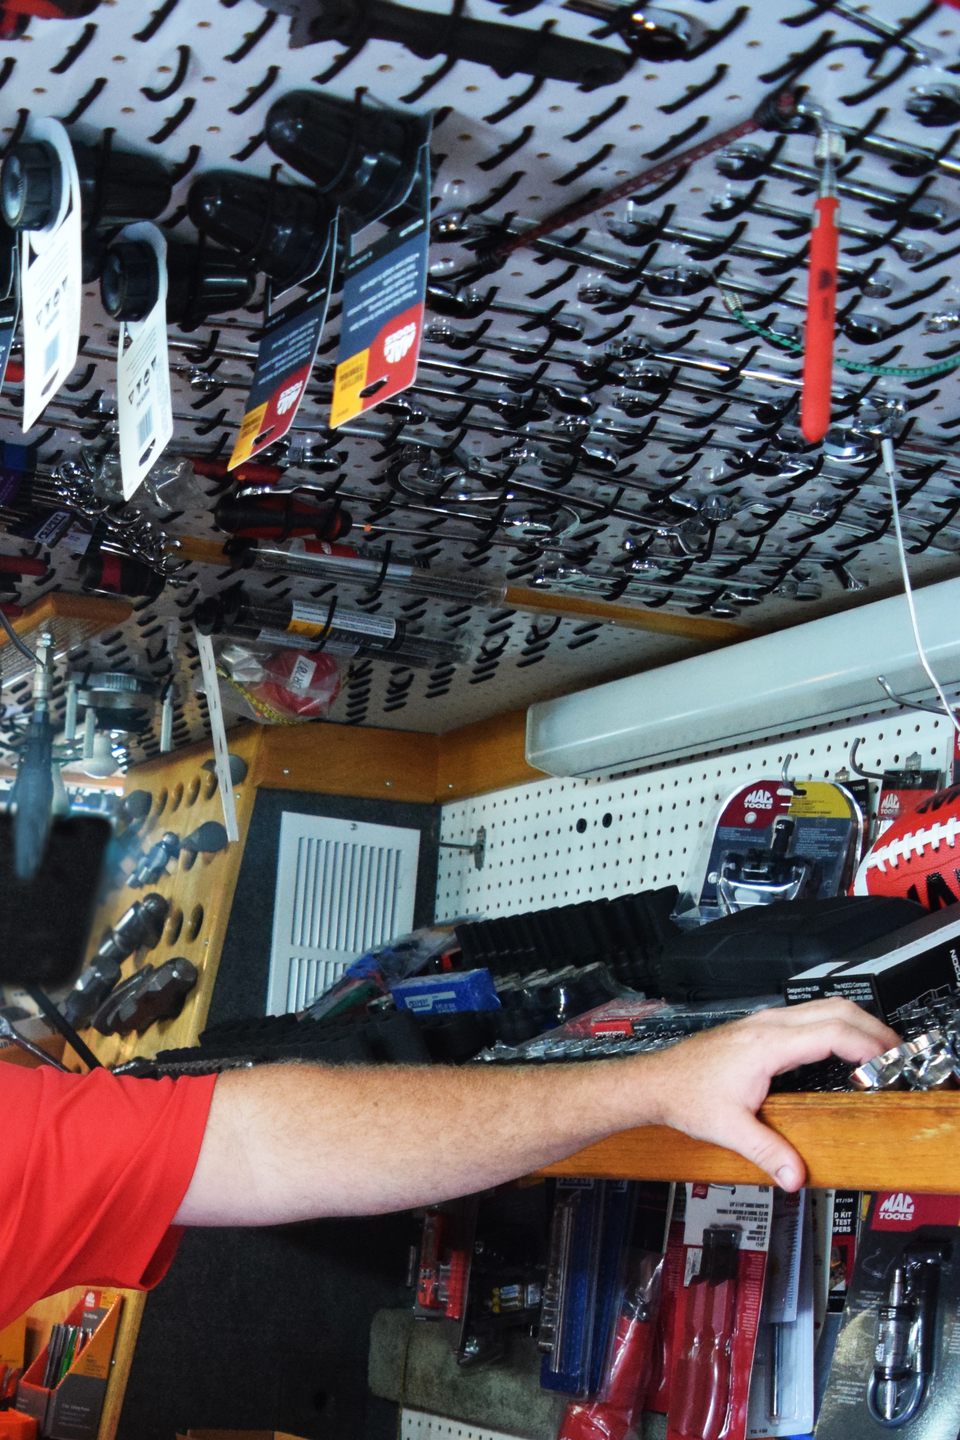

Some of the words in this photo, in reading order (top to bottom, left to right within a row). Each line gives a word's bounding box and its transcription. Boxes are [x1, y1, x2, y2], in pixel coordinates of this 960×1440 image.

[744, 789, 773, 804] MAC
[881, 793, 900, 809] MAC
[743, 802, 772, 810] TOOLS
[880, 1193, 915, 1213] MAC
[879, 1212, 913, 1220] TOOLS
